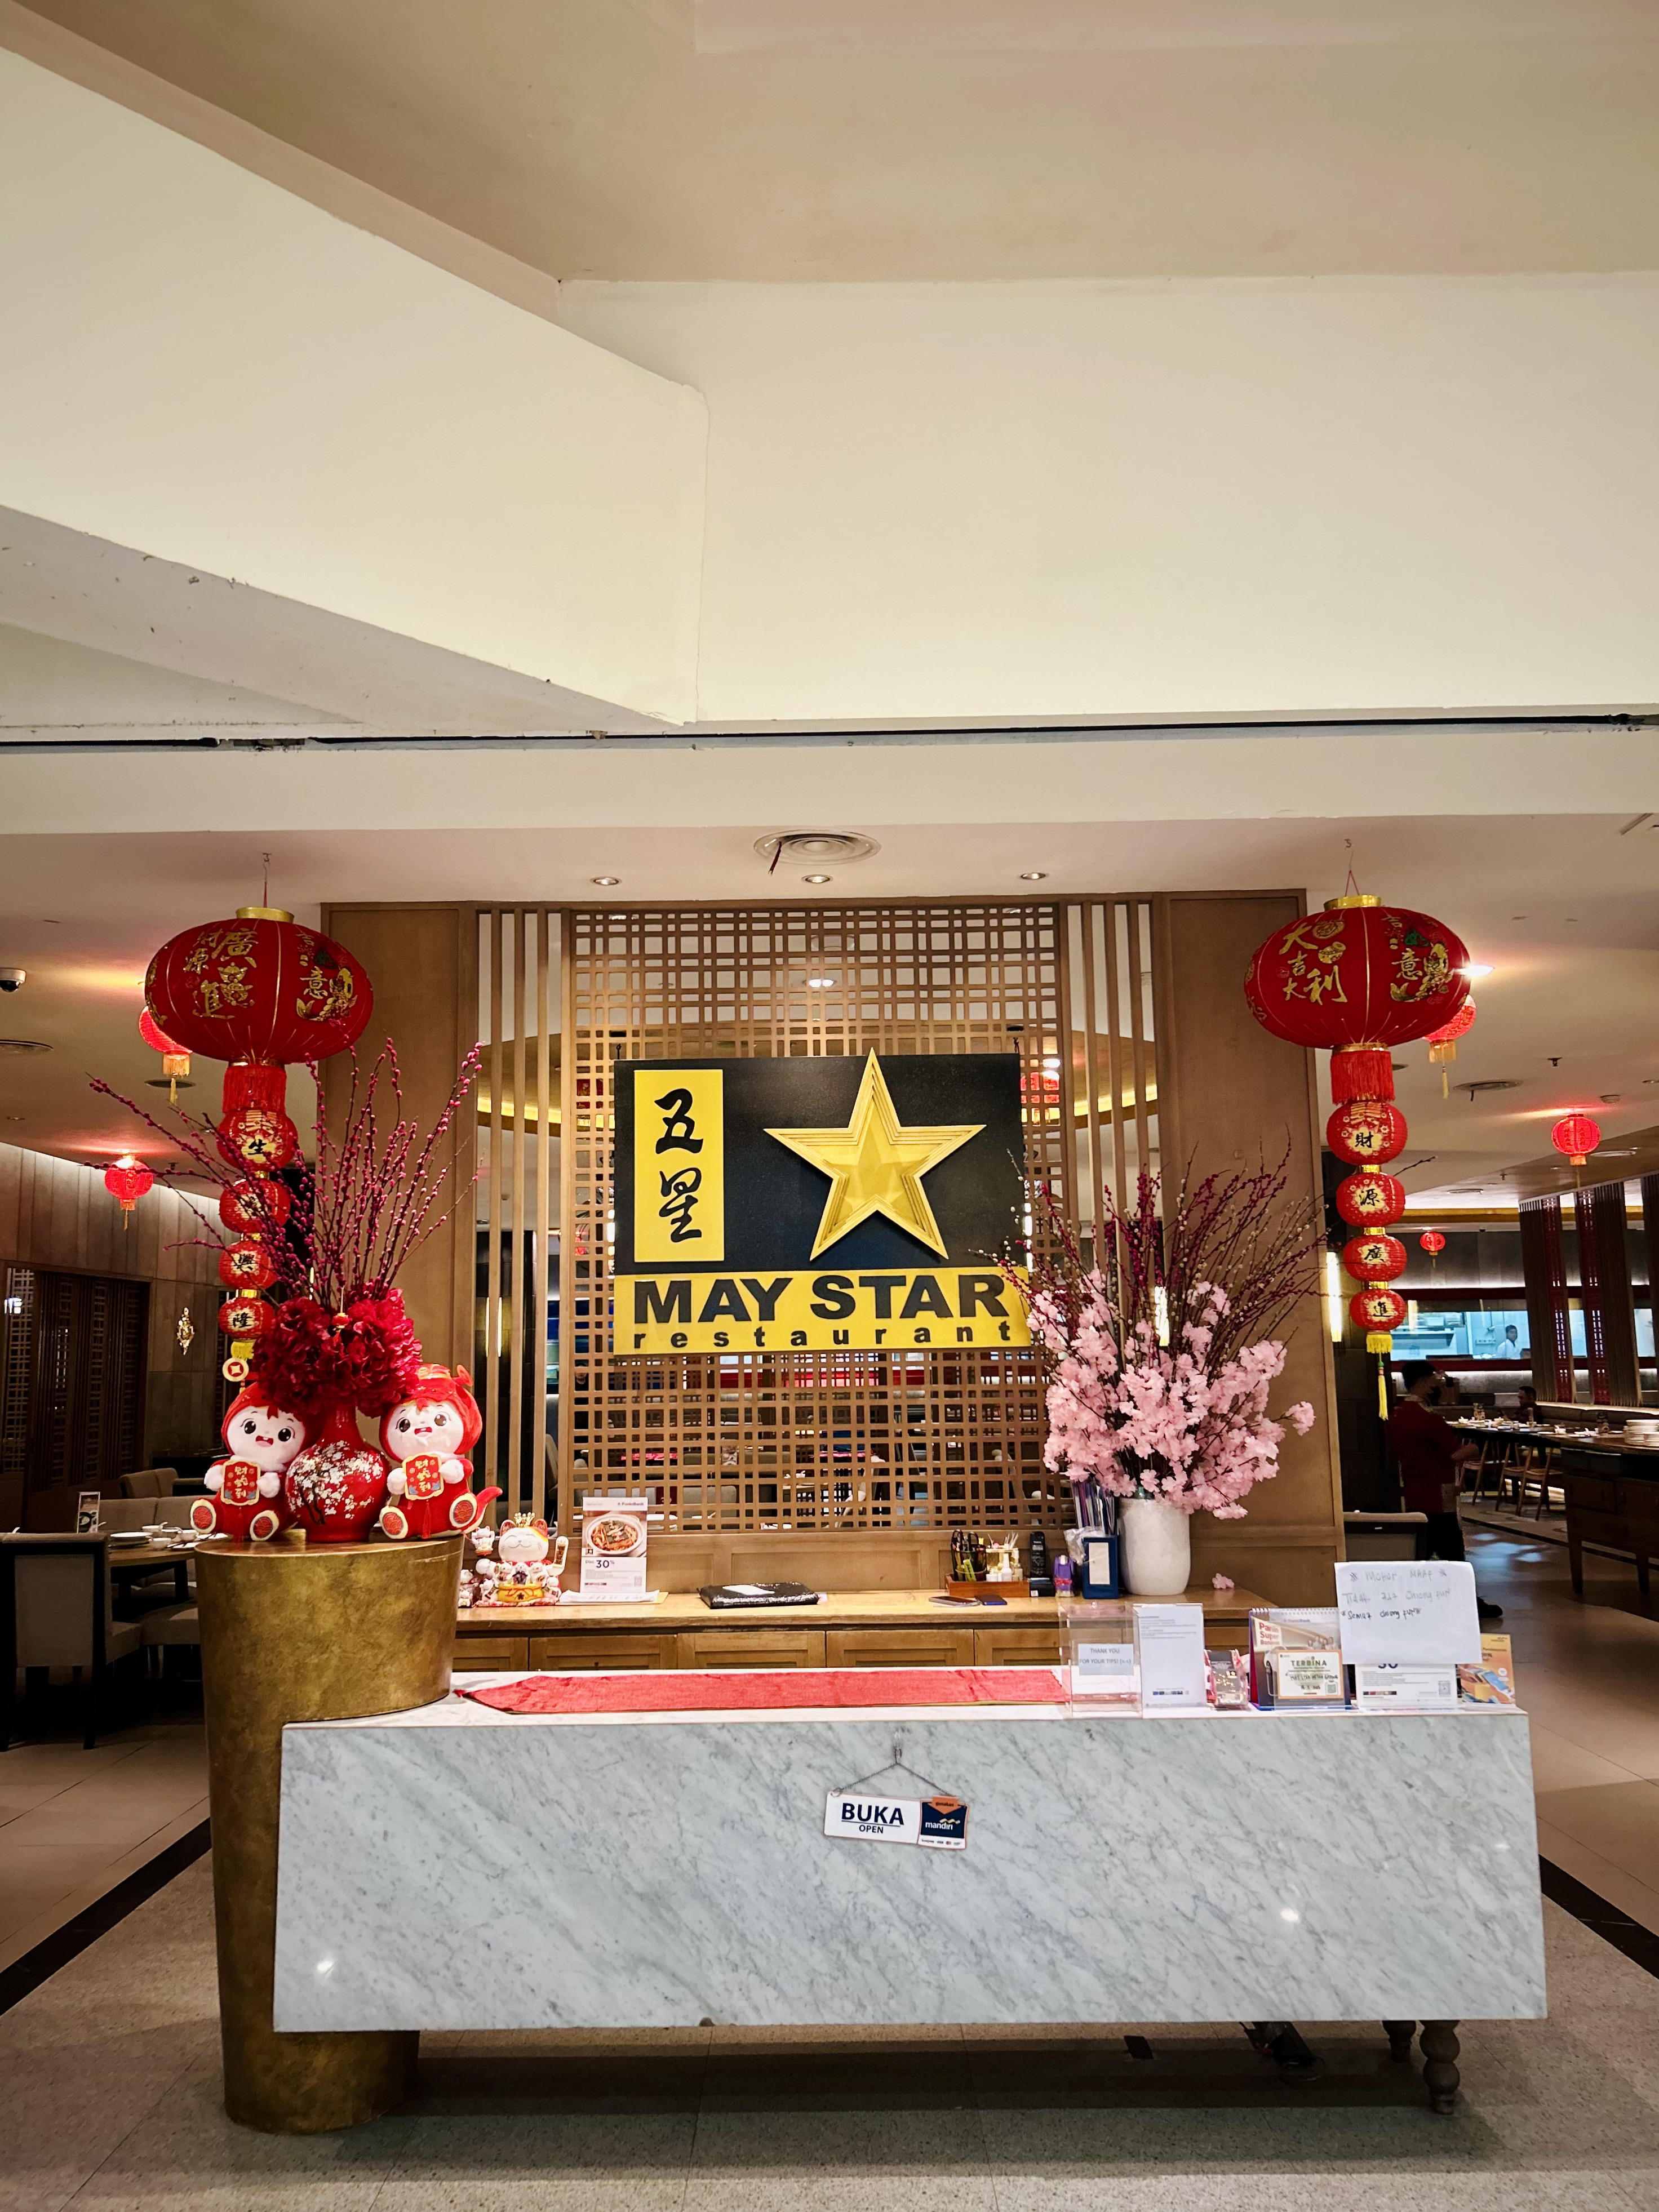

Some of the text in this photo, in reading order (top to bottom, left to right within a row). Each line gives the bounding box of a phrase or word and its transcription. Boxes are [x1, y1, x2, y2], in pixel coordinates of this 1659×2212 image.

[1391, 948, 1423, 980] 意
[300, 966, 327, 1000] 意
[248, 1139, 267, 1156] 生
[1355, 1132, 1374, 1149] 財
[654, 1088, 704, 1243] 五星
[1359, 1189, 1380, 1206] 源
[1364, 1245, 1385, 1263] 廣
[634, 1274, 1010, 1323] MAY STAR
[1373, 1302, 1392, 1317] 進
[233, 1312, 253, 1328] 隆
[634, 1320, 1010, 1349] restaurant
[1259, 1622, 1279, 1633] Panin
[1260, 1631, 1279, 1640] Super
[841, 1802, 904, 1825] BUKA
[859, 1824, 884, 1834] OPEN
[925, 1822, 953, 1830] mandiri
